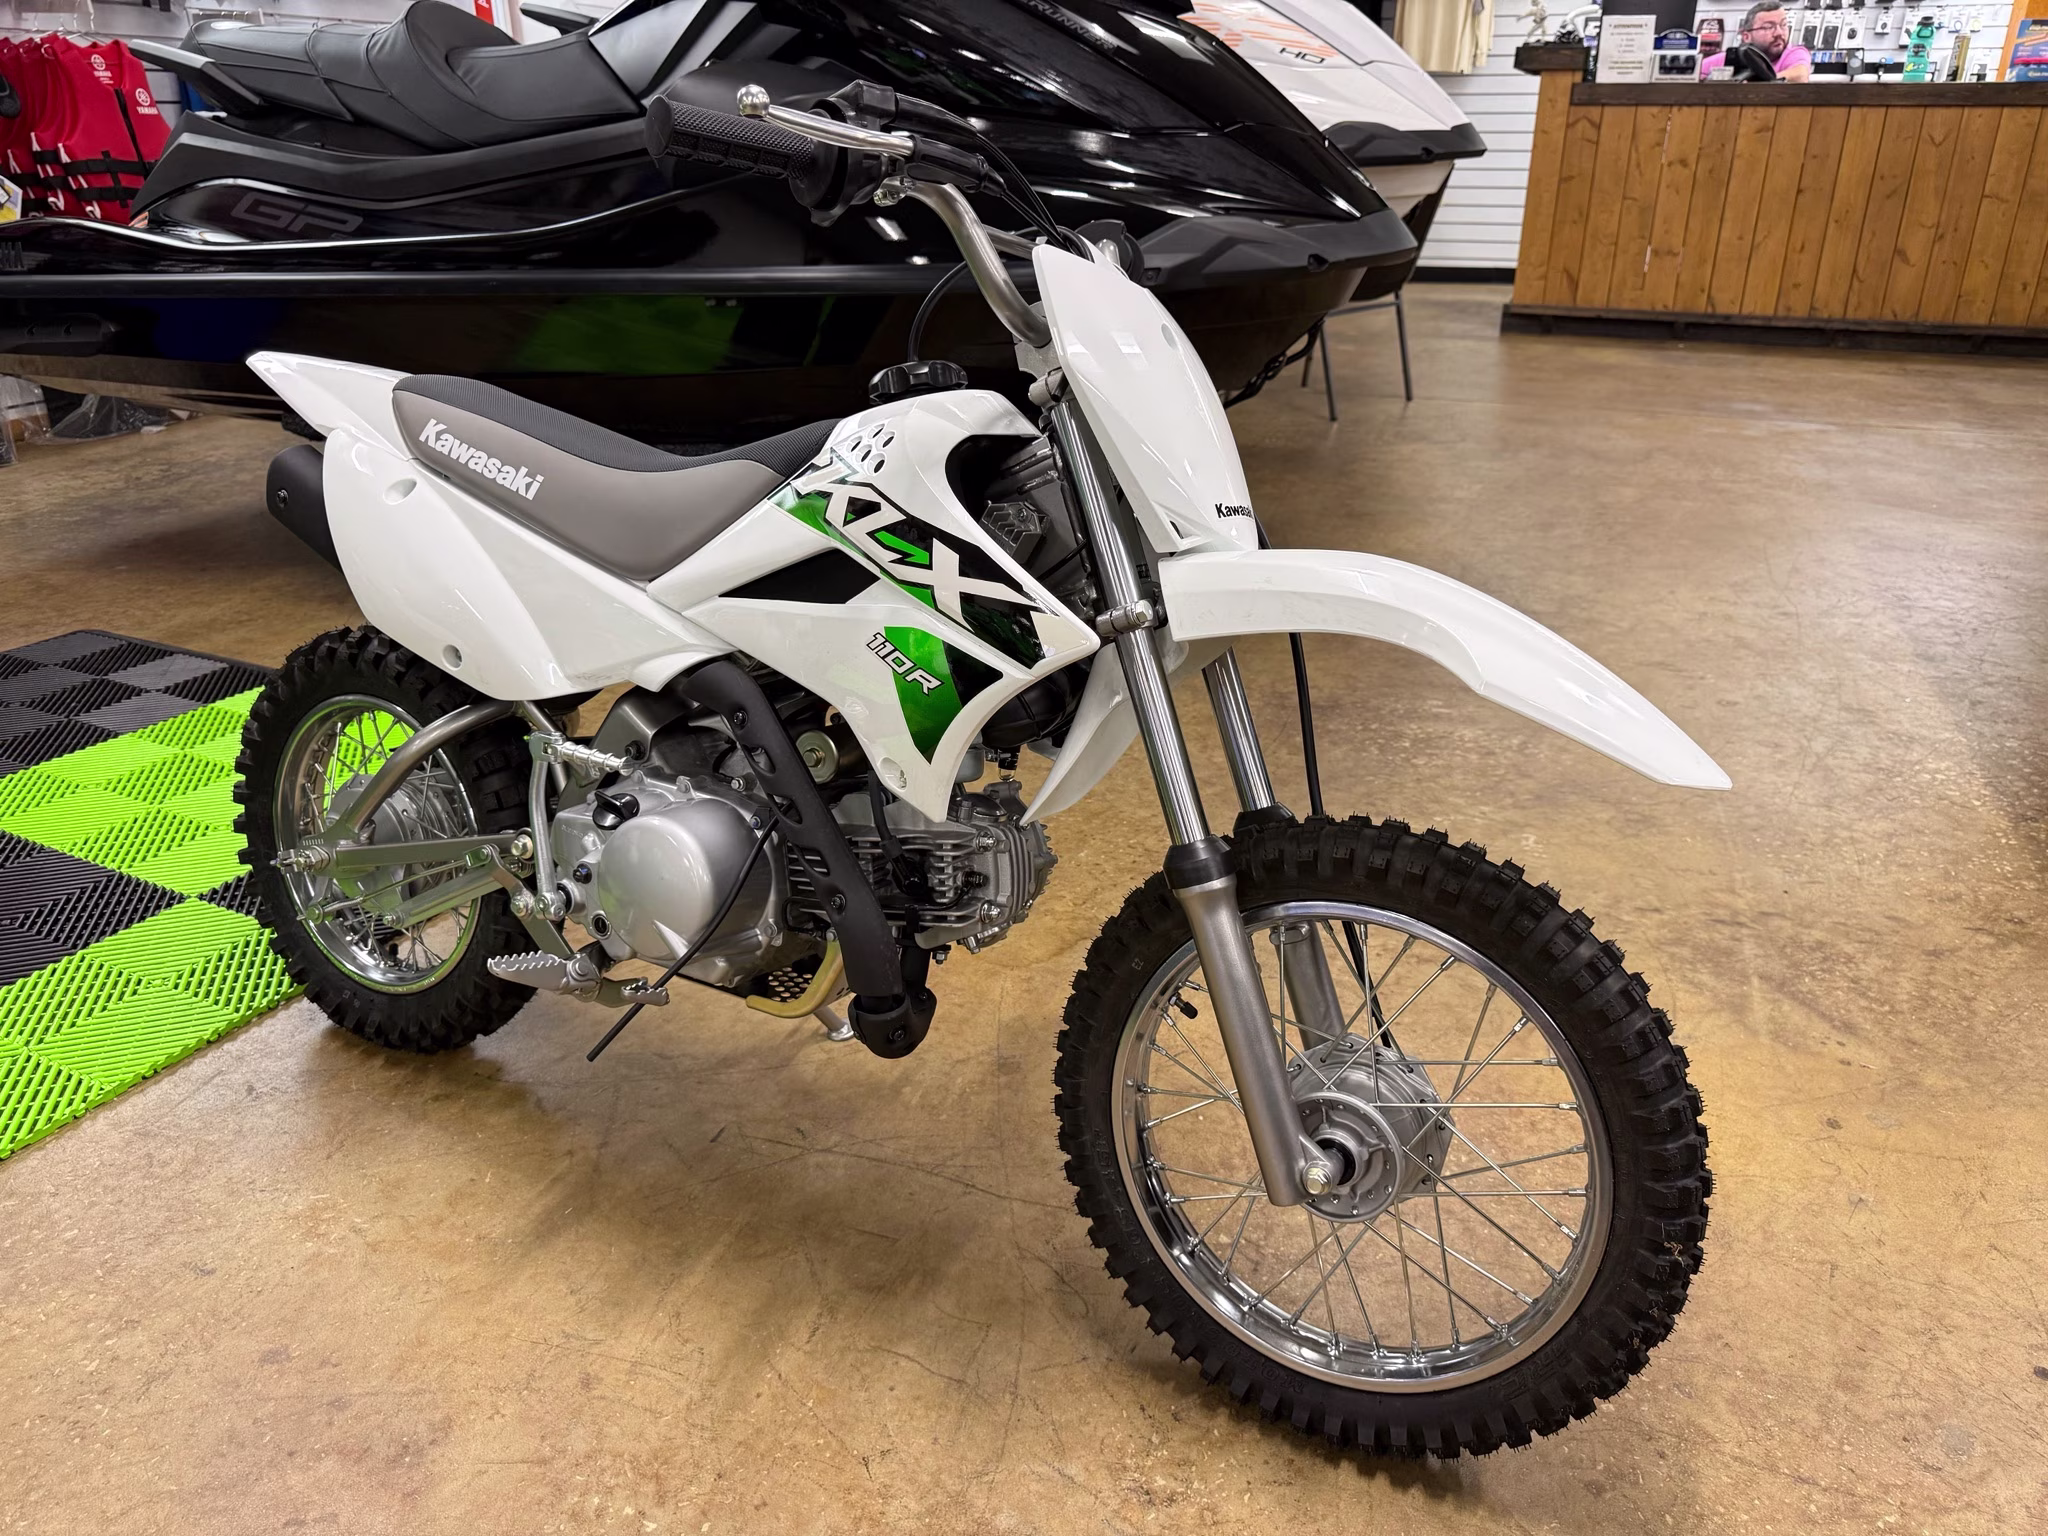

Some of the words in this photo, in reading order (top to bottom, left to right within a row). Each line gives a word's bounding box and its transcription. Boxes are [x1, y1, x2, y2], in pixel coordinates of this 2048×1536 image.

[230, 191, 364, 233] GP
[419, 418, 544, 501] Kawasaki
[789, 445, 1042, 634] KLX
[866, 632, 943, 697] 110R
